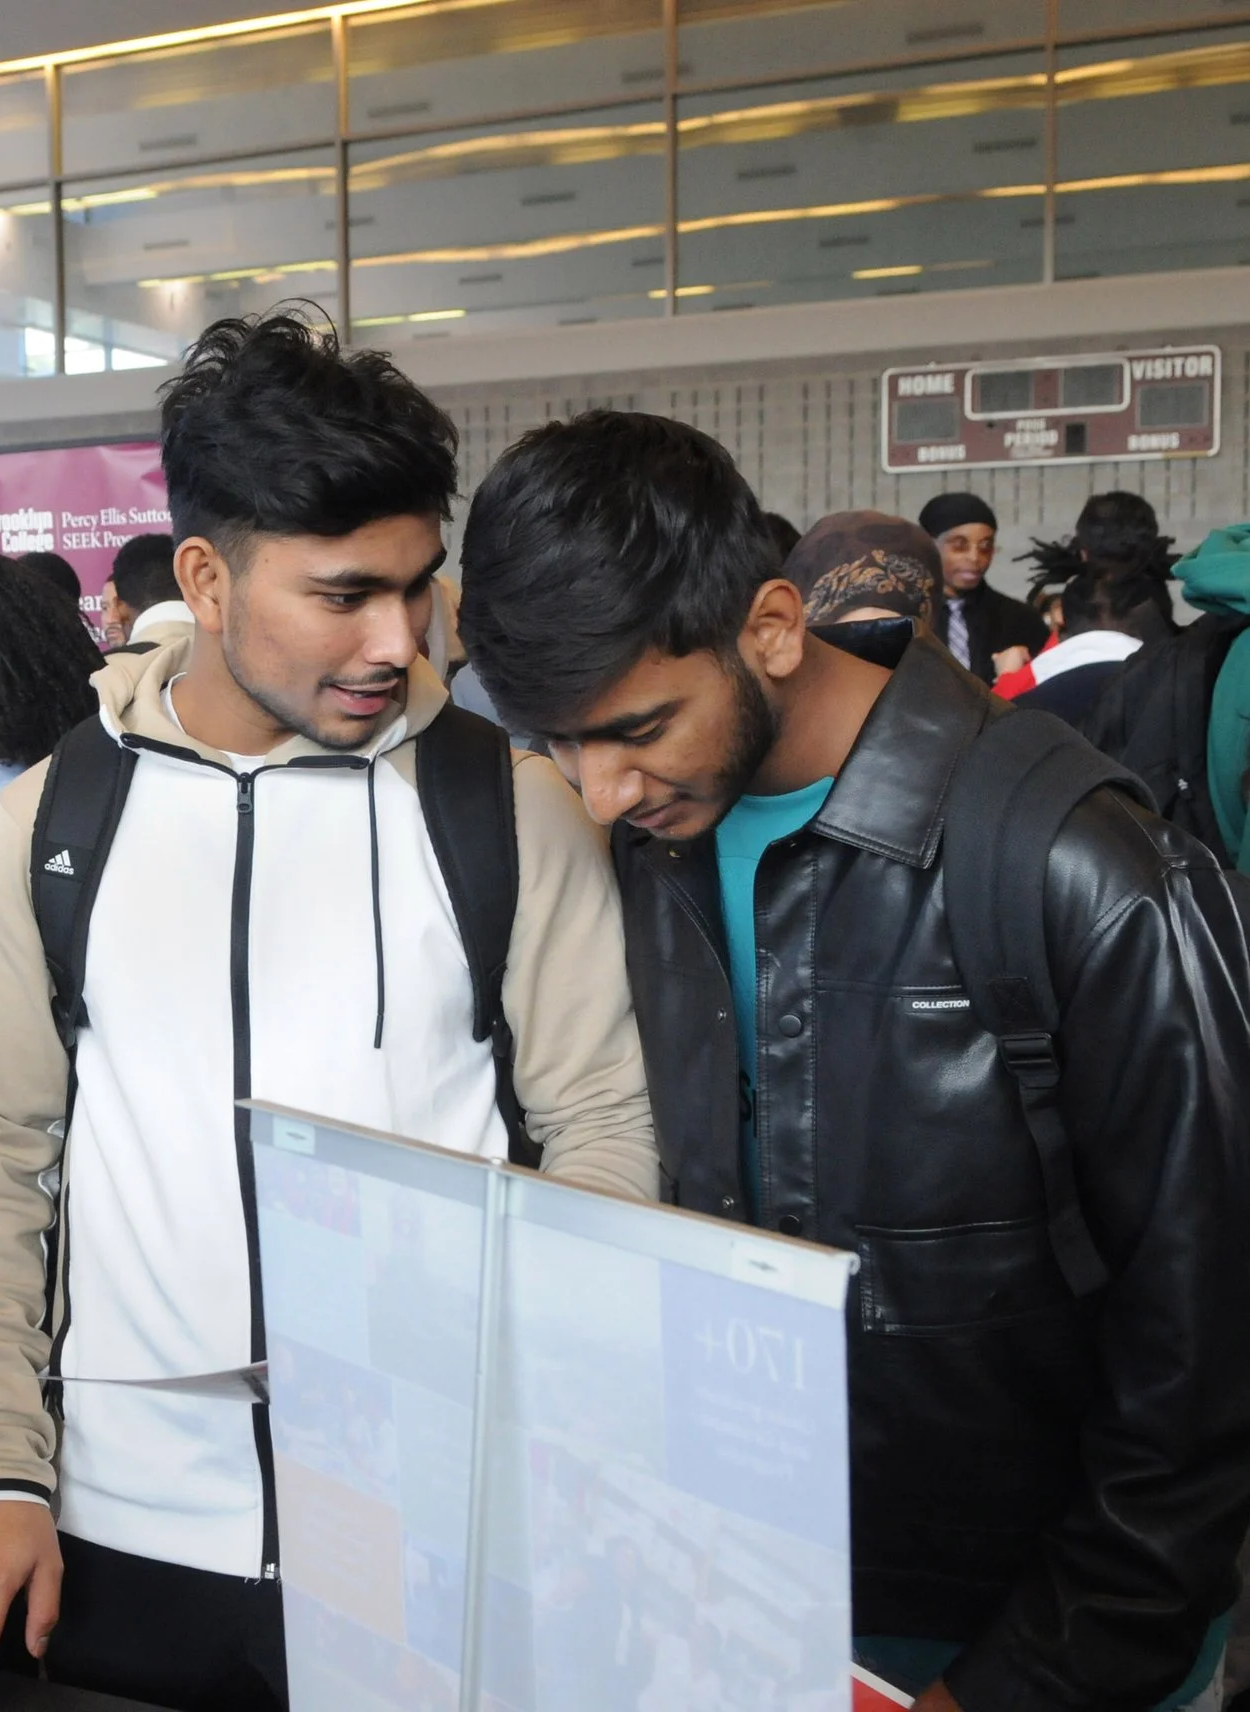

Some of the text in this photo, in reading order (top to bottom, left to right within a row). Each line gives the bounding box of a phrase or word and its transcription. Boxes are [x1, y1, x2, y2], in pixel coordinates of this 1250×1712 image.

[1132, 355, 1213, 380] VISITOR
[898, 373, 954, 396] HOME
[1004, 430, 1058, 447] PERIOD
[1127, 432, 1180, 450] BONUS
[917, 444, 966, 462] BONUS
[62, 511, 98, 531] Percy
[100, 507, 127, 526] Ellis
[2, 531, 54, 553] College
[63, 532, 102, 550] SEEK
[44, 863, 75, 875] adidas
[912, 999, 970, 1009] COLLECTION
